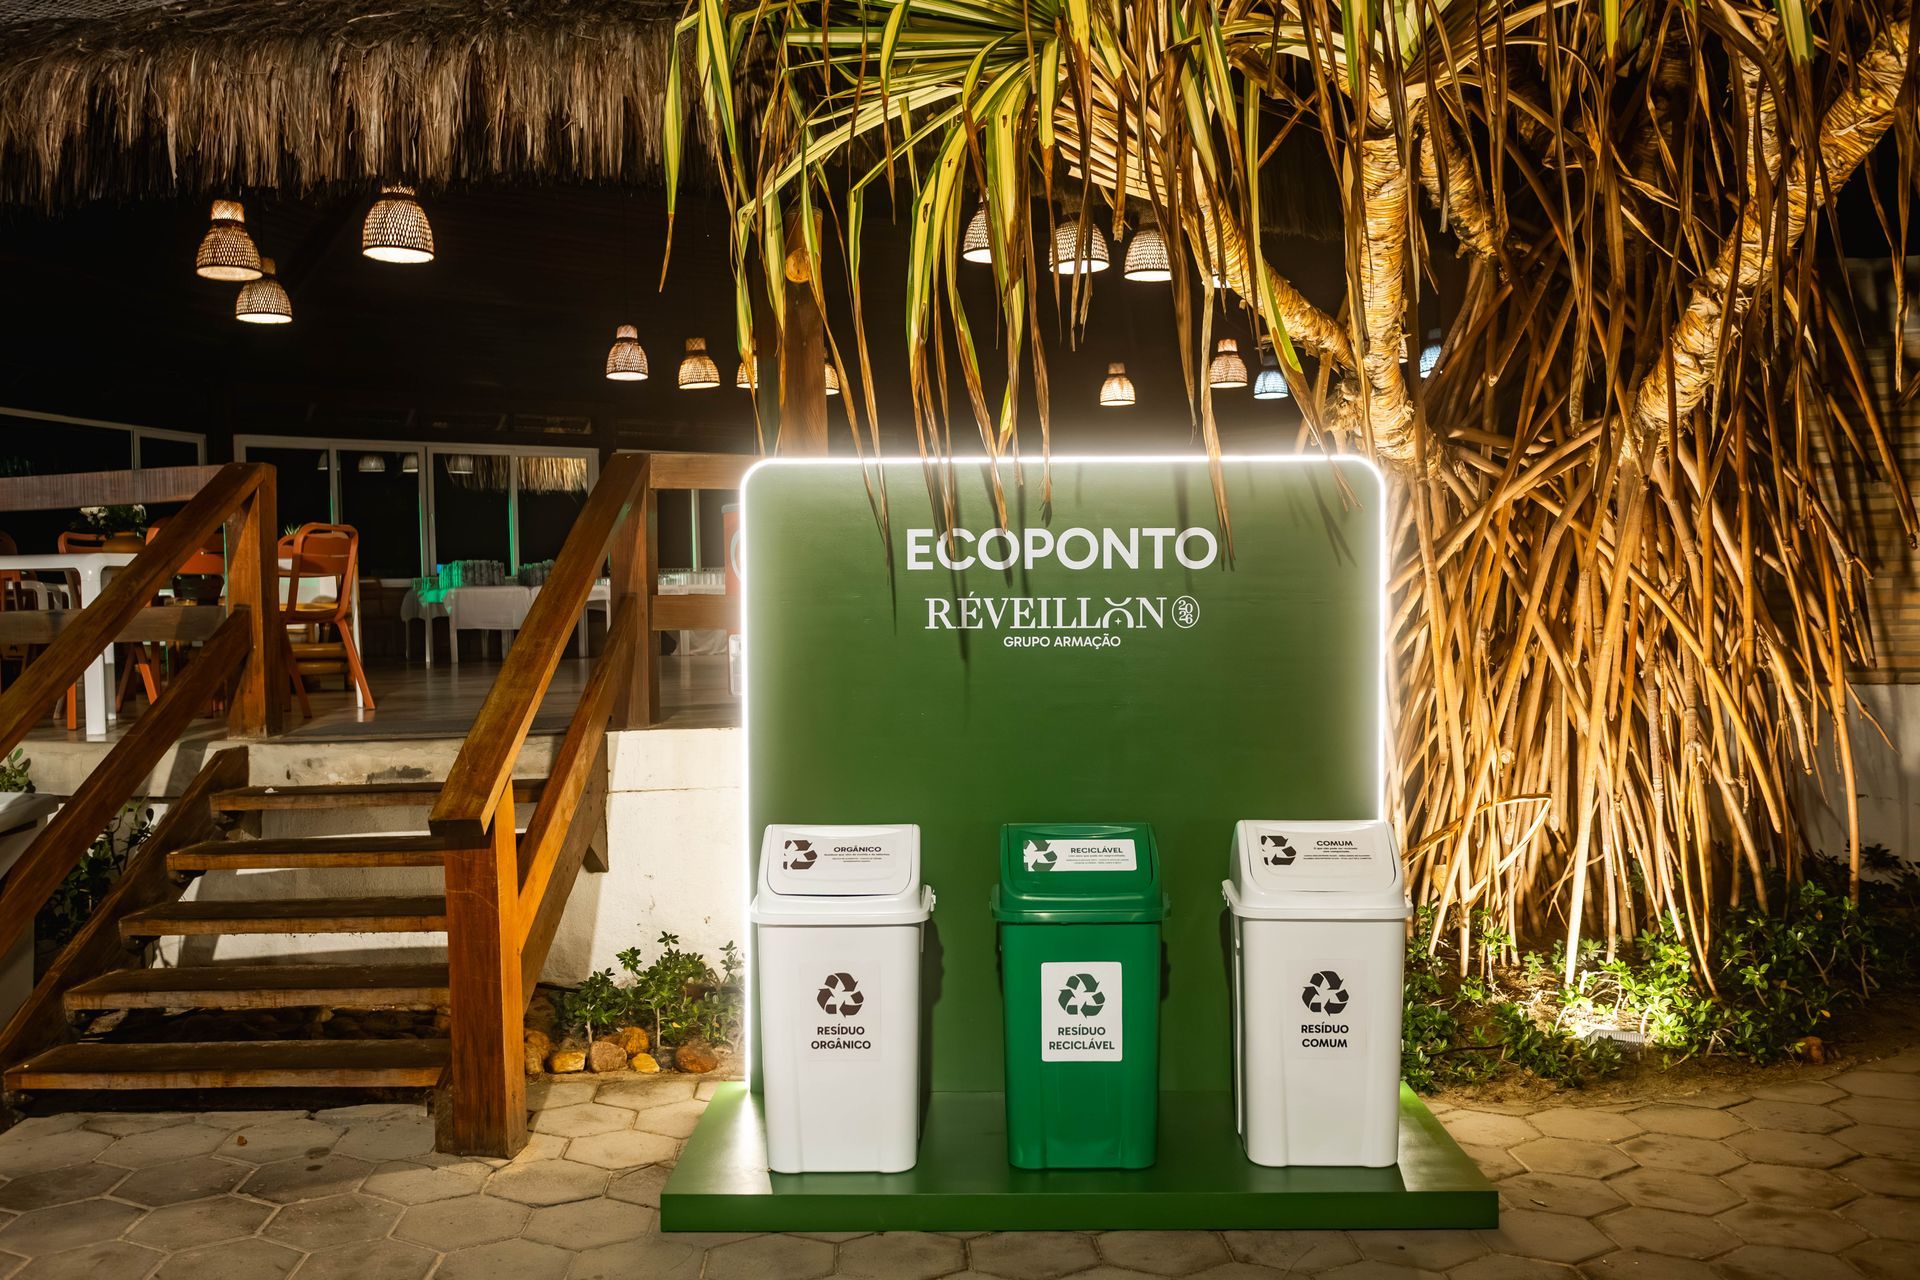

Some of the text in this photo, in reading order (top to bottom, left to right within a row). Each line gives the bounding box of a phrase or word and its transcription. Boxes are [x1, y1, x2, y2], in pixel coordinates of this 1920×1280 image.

[906, 527, 1218, 571] ECOPONTO
[925, 592, 1168, 630] RÉVEILLON
[1003, 634, 1122, 650] GRUPO ARMAÇÃO
[833, 845, 882, 853] ORGÂNICO
[1070, 845, 1123, 854] RECICLÁVEL
[817, 1024, 865, 1036] RESÍDUO
[1057, 1024, 1106, 1036] RESÍDUO
[1300, 1021, 1350, 1034] RESÍDUO
[811, 1038, 872, 1050] ORGÂNICO
[1048, 1038, 1116, 1051] RECICLÁVEL
[1301, 1038, 1348, 1048] COMUM
